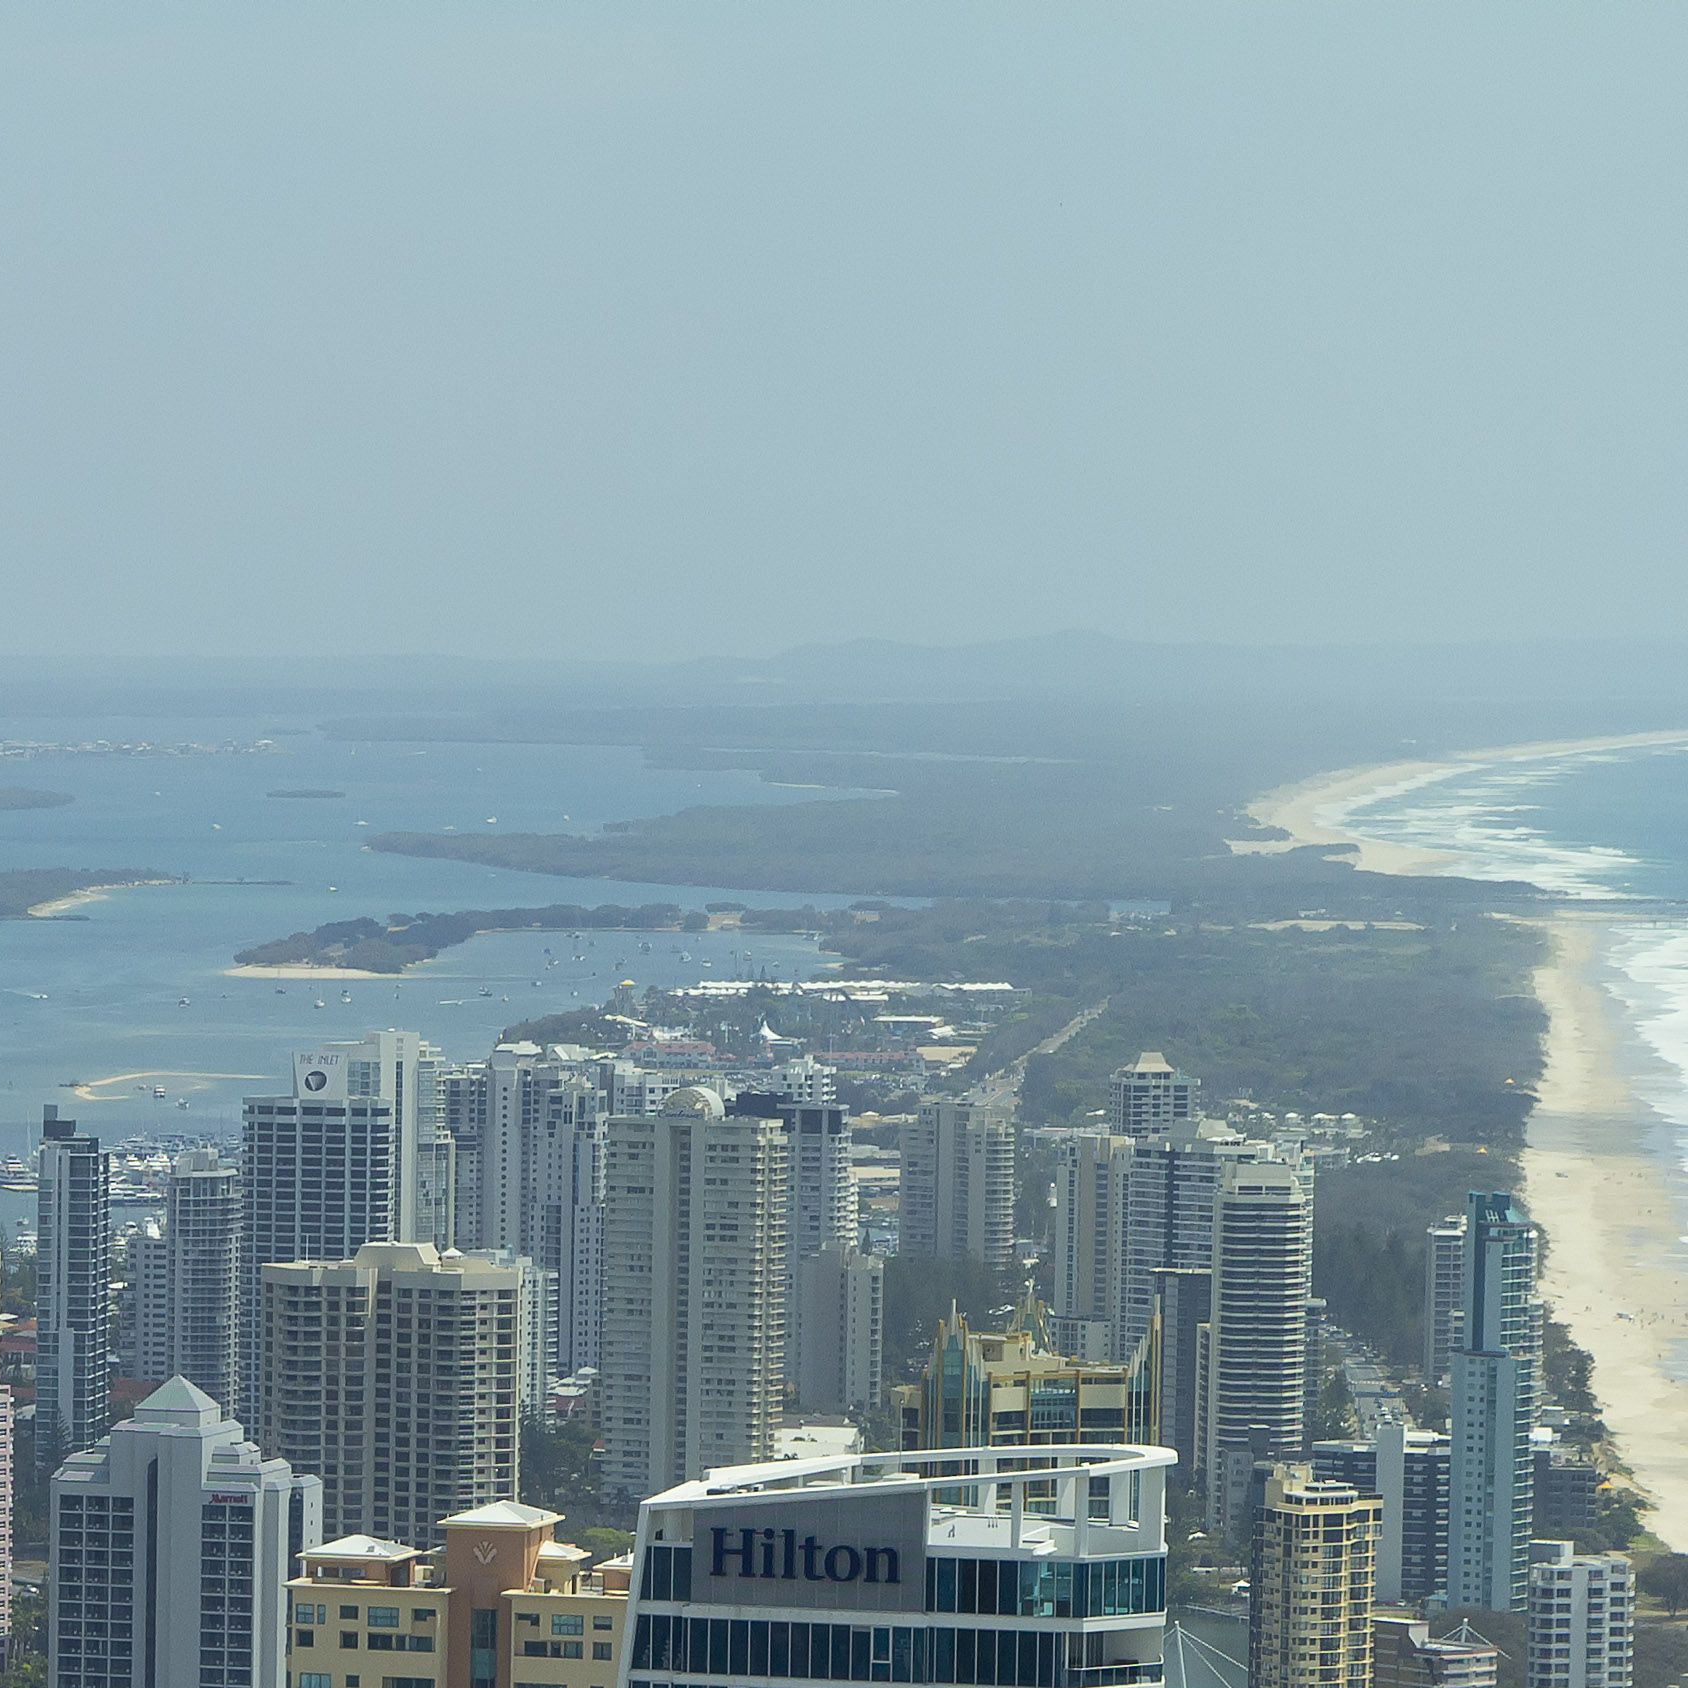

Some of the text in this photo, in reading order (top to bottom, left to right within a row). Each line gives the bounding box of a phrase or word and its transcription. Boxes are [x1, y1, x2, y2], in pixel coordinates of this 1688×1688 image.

[300, 1054, 339, 1065] THE INLET
[208, 1493, 248, 1505] Marriott
[710, 1527, 901, 1584] Hilton
